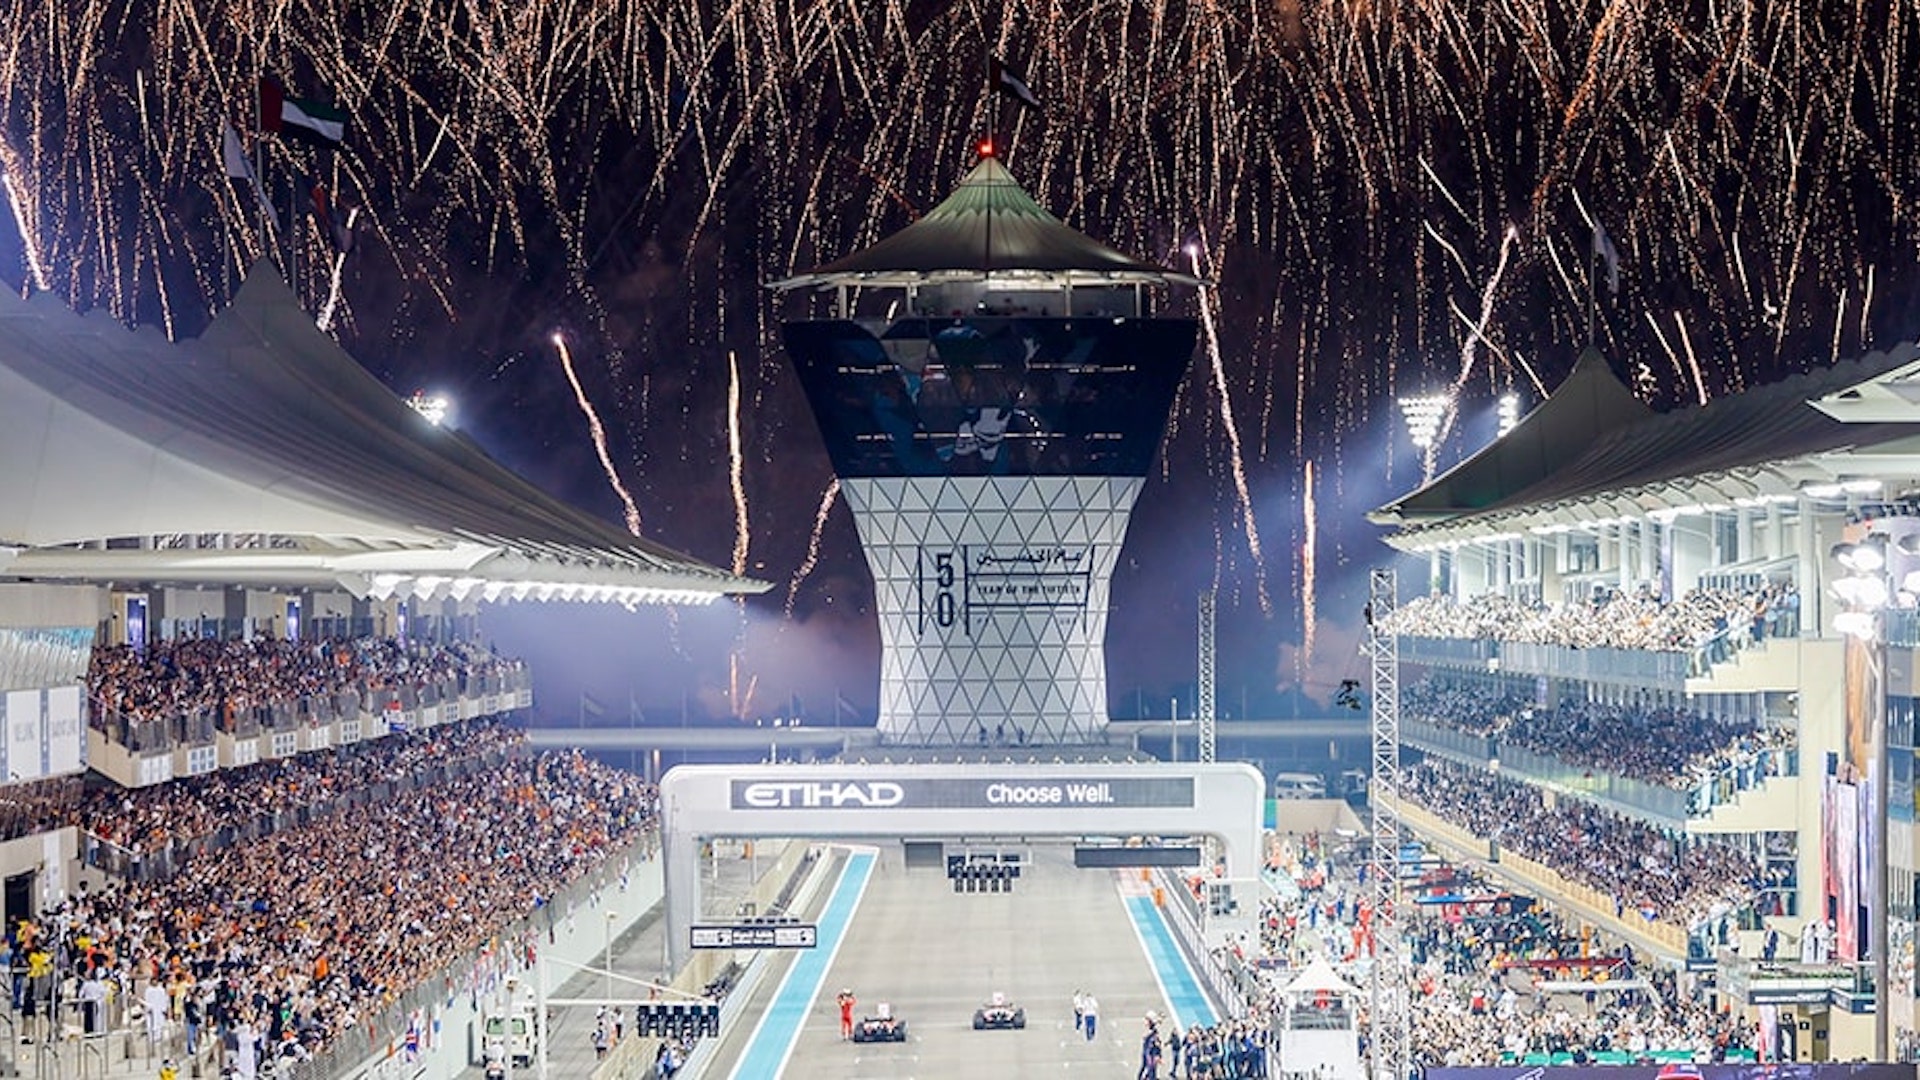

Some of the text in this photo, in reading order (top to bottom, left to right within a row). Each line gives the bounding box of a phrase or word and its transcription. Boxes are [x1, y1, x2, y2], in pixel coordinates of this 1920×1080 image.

[744, 782, 1114, 807] ETIHAD Choose Well.
